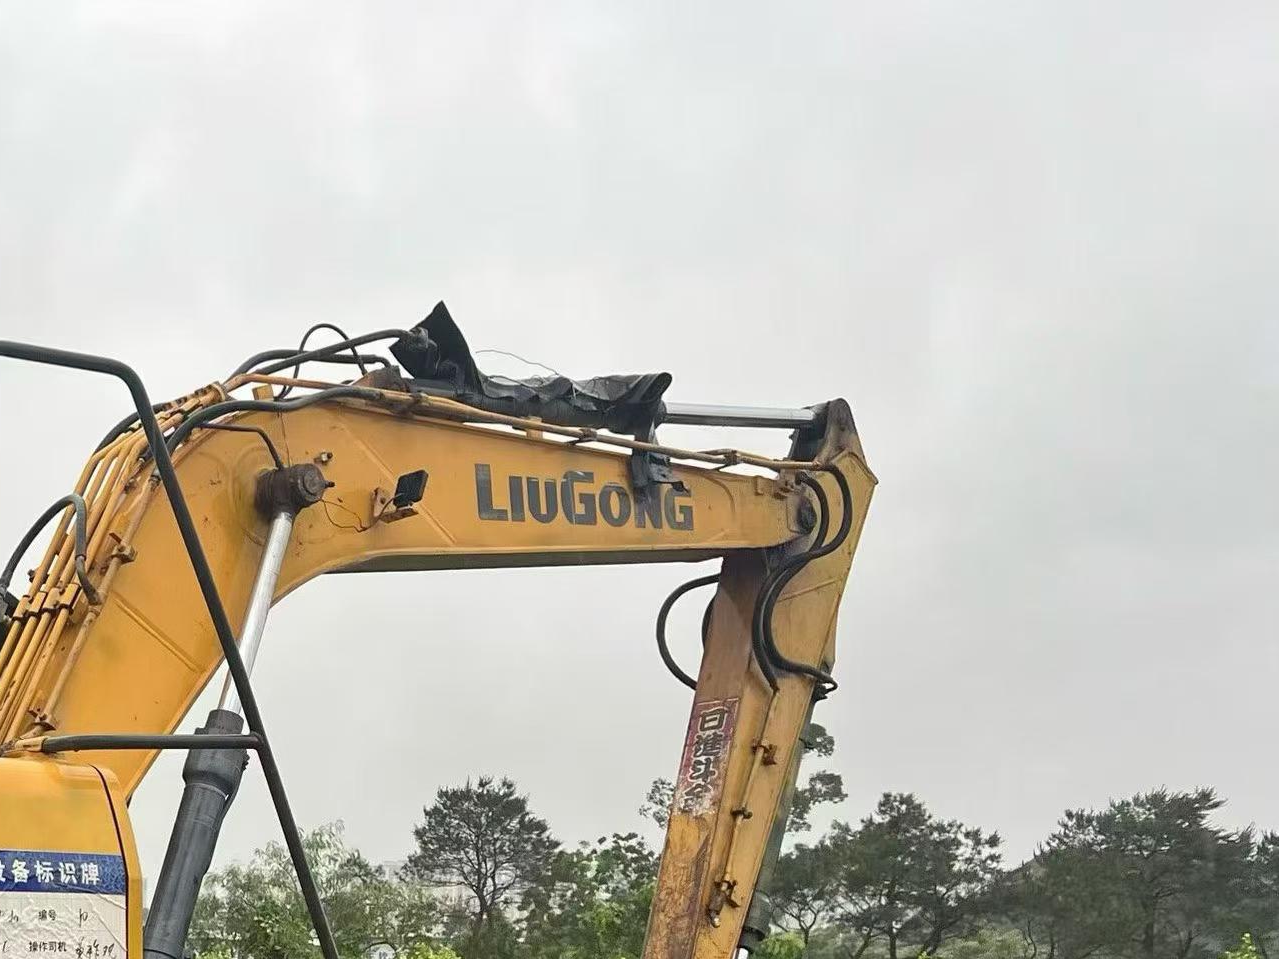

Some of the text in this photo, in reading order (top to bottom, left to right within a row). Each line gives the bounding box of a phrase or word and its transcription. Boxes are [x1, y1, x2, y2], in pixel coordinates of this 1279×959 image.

[38, 909, 57, 921] 编号
[28, 941, 68, 953] 操作司机
